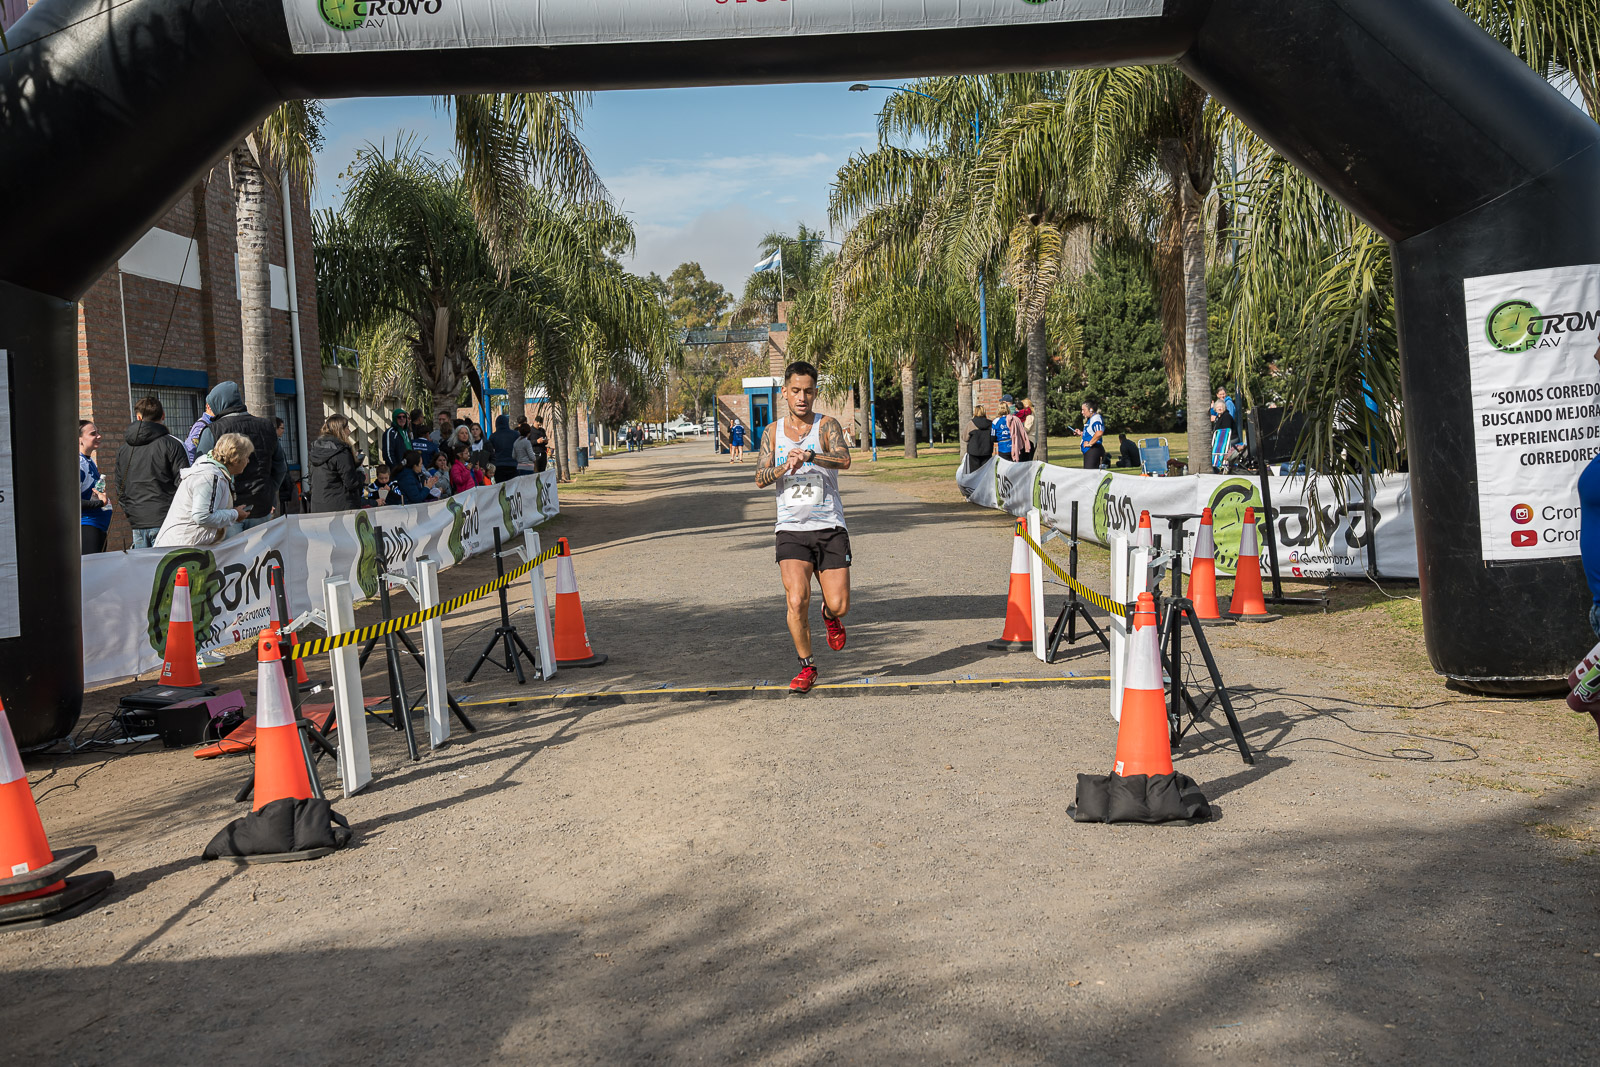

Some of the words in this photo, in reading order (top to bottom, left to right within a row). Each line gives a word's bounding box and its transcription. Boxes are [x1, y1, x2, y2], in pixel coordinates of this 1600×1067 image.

[353, 19, 385, 29] RAV
[1526, 309, 1600, 336] CRON
[1525, 337, 1561, 350] RAV
[1481, 408, 1553, 427] BUSCANDO
[1495, 426, 1585, 447] EXPERIENCIAS
[791, 482, 815, 499] 24
[1300, 552, 1355, 566] @cronorav
